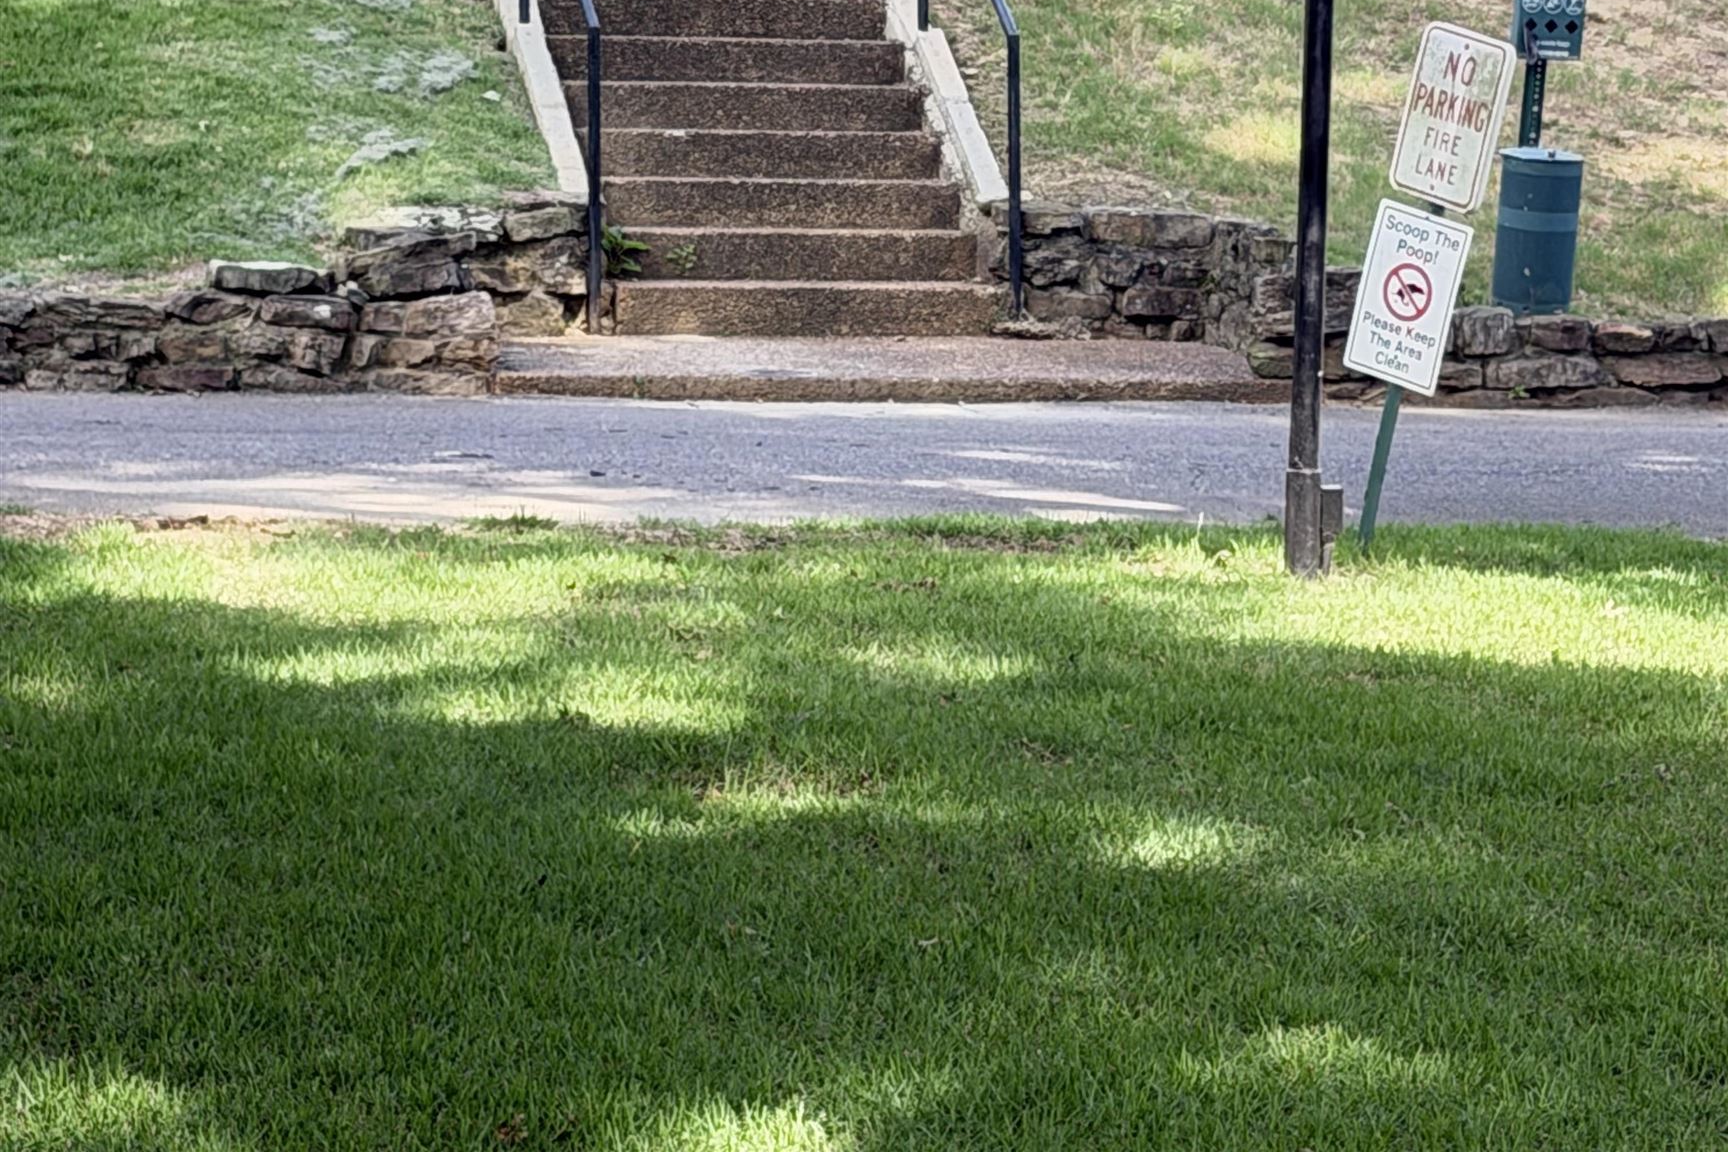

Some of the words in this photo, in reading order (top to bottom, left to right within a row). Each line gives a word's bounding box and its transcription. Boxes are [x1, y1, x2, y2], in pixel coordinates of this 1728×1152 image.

[1442, 51, 1477, 86] NO
[1413, 82, 1489, 133] PARKING
[1424, 127, 1461, 156] FIRE
[1415, 154, 1458, 186] LANE
[1385, 214, 1430, 242] Scoop
[1435, 230, 1460, 251] The
[1396, 239, 1439, 265] Poop!
[1362, 311, 1402, 336] Please
[1405, 326, 1436, 348] Keep
[1369, 331, 1392, 348] The
[1394, 341, 1423, 361] Area
[1374, 351, 1409, 374] Clean
